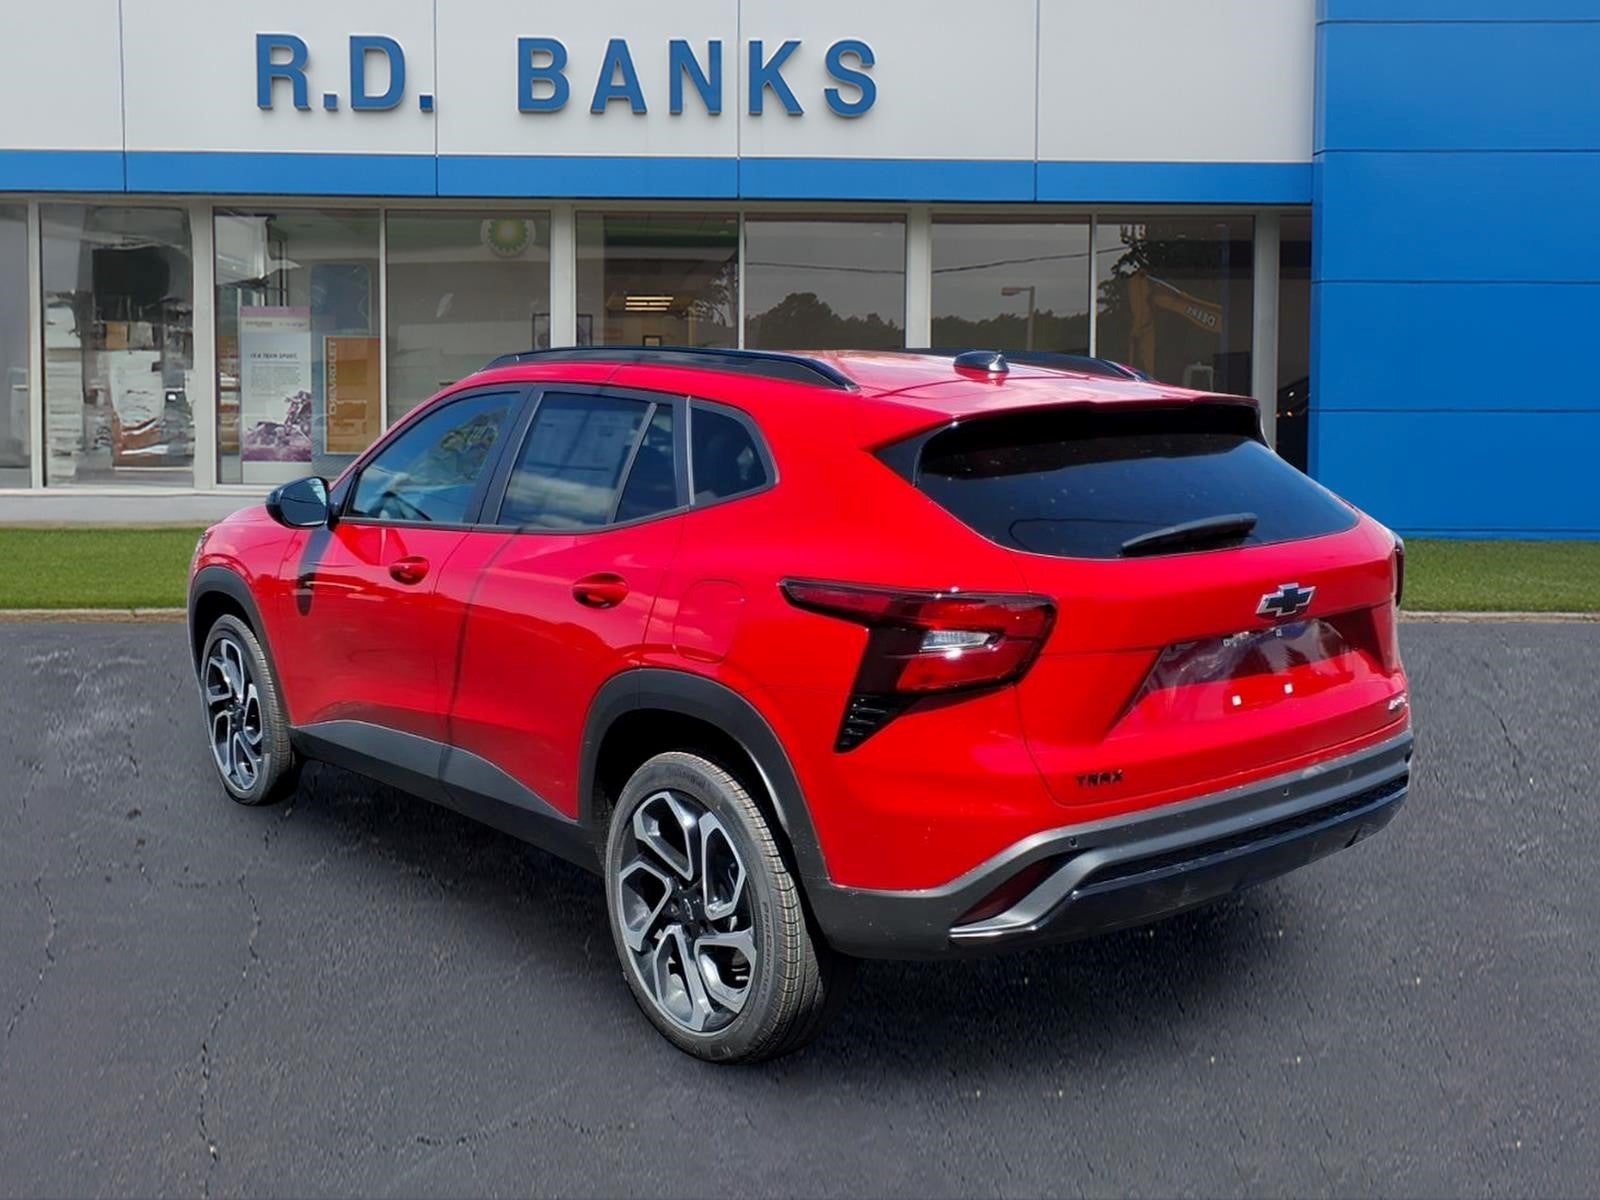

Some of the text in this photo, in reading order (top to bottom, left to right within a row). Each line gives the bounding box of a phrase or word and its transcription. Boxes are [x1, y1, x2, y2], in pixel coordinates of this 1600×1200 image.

[256, 33, 877, 118] R.D. BANKS
[327, 337, 337, 416] CHEVROLET
[1075, 769, 1124, 788] TRAX
